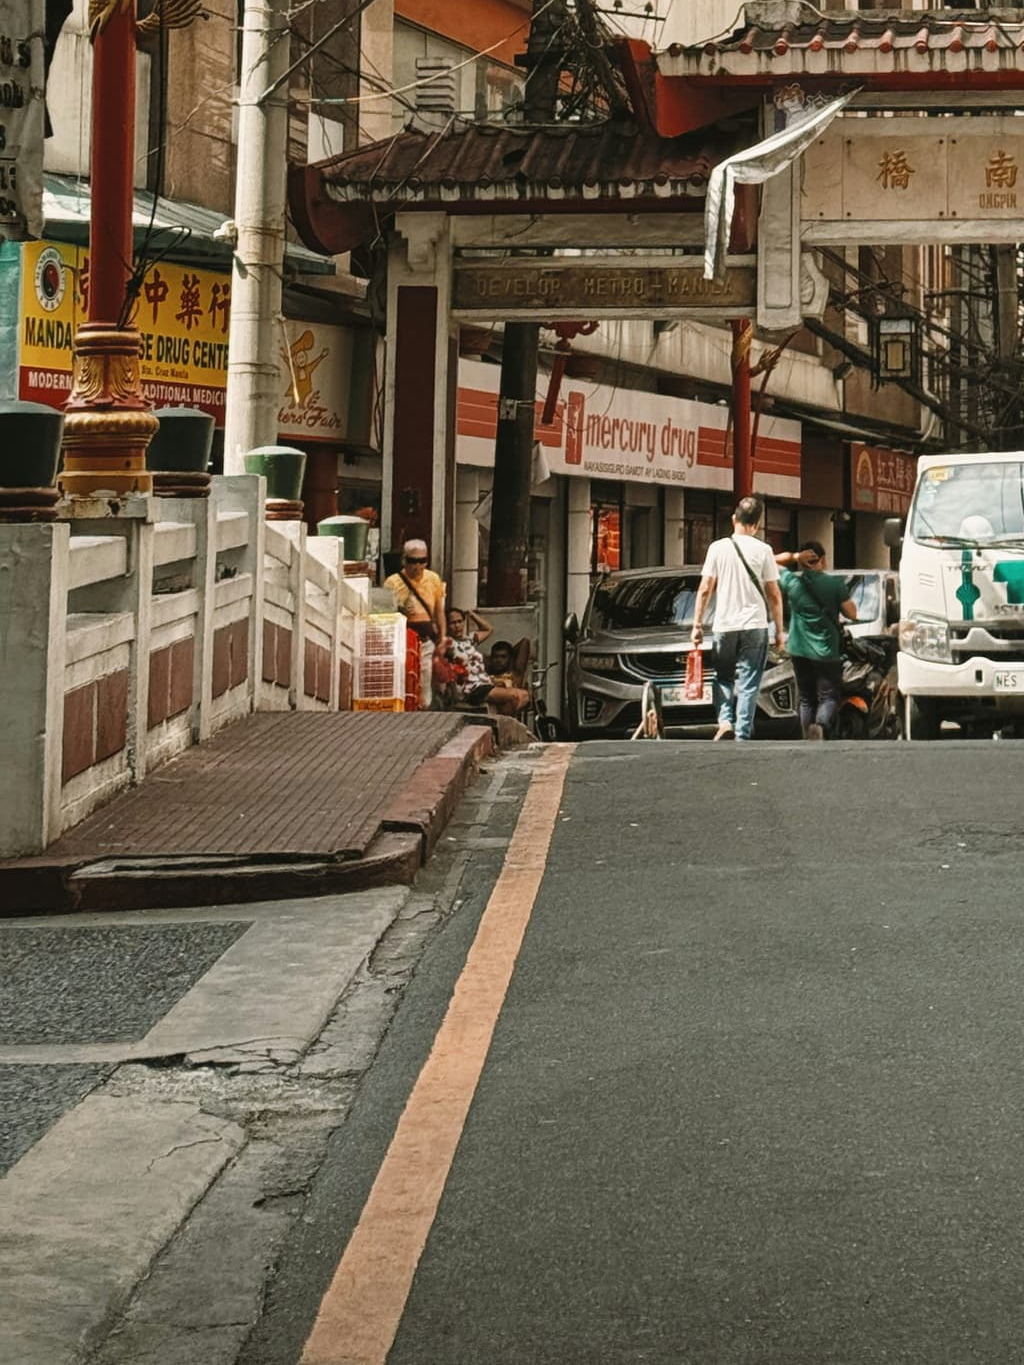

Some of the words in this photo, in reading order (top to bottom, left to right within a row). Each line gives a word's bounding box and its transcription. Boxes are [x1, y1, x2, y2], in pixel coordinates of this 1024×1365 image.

[979, 193, 1017, 209] ONGPIN
[477, 277, 560, 296] DEVELOP
[584, 277, 645, 296] METRO
[25, 317, 73, 350] MANDA
[157, 336, 190, 365] DRUG
[193, 340, 229, 370] CENTE
[143, 384, 191, 402] ADITIONAL
[193, 388, 227, 405] MEDICI
[585, 414, 657, 462] mercury
[661, 417, 695, 468] drug
